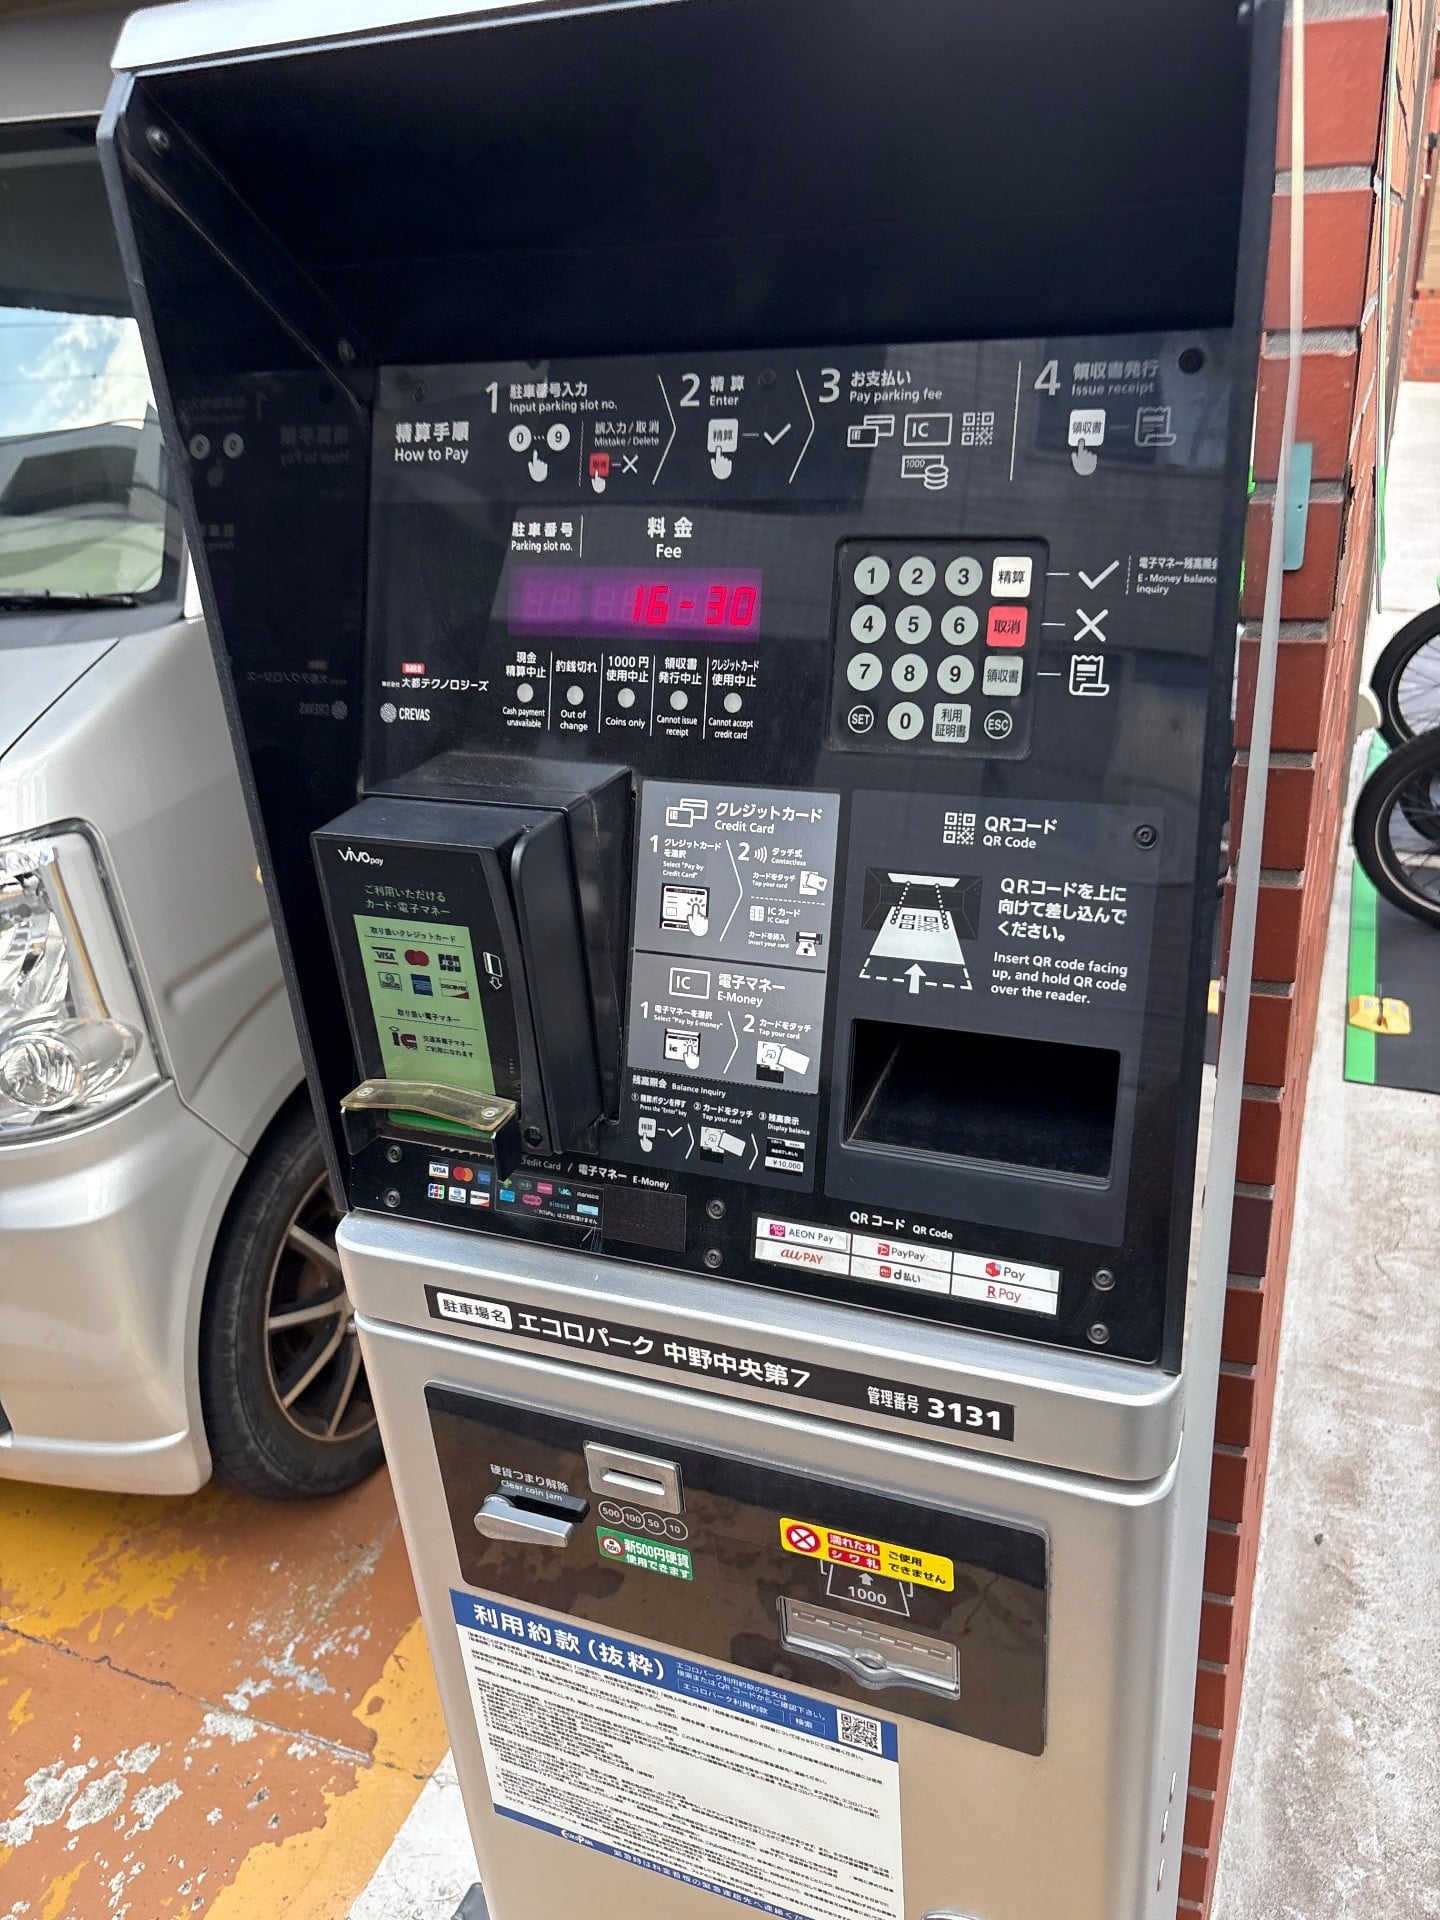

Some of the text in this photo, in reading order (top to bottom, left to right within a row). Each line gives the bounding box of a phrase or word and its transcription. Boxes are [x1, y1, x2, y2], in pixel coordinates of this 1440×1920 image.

[818, 368, 841, 403] 3
[850, 370, 912, 388] お支払い
[1034, 360, 1061, 396] 4
[509, 382, 588, 399] 駐車番号入力
[679, 373, 700, 407] 2
[849, 388, 943, 405] Pay parking fee
[1071, 381, 1155, 397] Issue receipt
[485, 382, 499, 414] 1
[510, 401, 536, 413] Input
[538, 400, 578, 413] parking
[580, 399, 599, 411] slot
[709, 395, 739, 407] Enter
[395, 421, 470, 441] 精算手順
[911, 421, 929, 438] IC
[395, 447, 469, 463] How to Pay
[905, 458, 925, 468] 1000
[512, 522, 574, 538] 駐車番号
[647, 516, 693, 539] 料金
[511, 540, 573, 554] Parking slot no.
[655, 543, 682, 558] Fee
[867, 568, 876, 584] 1
[911, 568, 923, 584] 2
[957, 568, 970, 585] 3
[998, 569, 1025, 585] 精算
[862, 616, 874, 632] 4
[908, 616, 919, 633] 5
[953, 617, 965, 634] 6
[993, 619, 1021, 634] 取消
[516, 651, 537, 663] 現金
[664, 657, 697, 670] 領収書
[505, 665, 547, 679] 精算中止
[555, 659, 598, 674] 釣銭切れ
[711, 659, 759, 672] クレジットカード
[860, 663, 872, 680] 7
[903, 664, 915, 681] 8
[606, 669, 649, 683] 使用中止
[658, 672, 702, 685] 発行中止
[711, 673, 757, 688] 使用中止
[949, 666, 961, 683] 9
[987, 668, 1020, 684] 領収書
[401, 678, 489, 691] 大都テクノロジーズ
[399, 707, 431, 721] CREVAS
[502, 707, 545, 718] Cash payment
[560, 710, 587, 719] Out of
[656, 715, 698, 726] Cannot issue
[851, 712, 871, 725] SET
[941, 708, 962, 722] 利用
[506, 718, 542, 729] unavailable
[560, 721, 588, 731] change
[605, 717, 646, 729] Coins only
[708, 718, 754, 730] Cannot accept
[899, 713, 911, 730] 0
[987, 718, 1009, 731] ESC
[665, 727, 689, 738] receipt
[714, 729, 748, 739] credit card
[935, 723, 967, 738] 証明書
[716, 802, 823, 823] クレジットカード
[714, 820, 775, 834] Credit Card
[984, 816, 1058, 834] QRコード
[650, 835, 659, 853] 1
[664, 838, 722, 851] クレジットカード
[983, 835, 1037, 849] QR Code
[738, 842, 750, 861] 2
[771, 847, 803, 858] タッチ式
[752, 871, 796, 882] カードをタッチ
[1000, 877, 1127, 902] QRコードを上に
[998, 900, 1127, 925] 向けて差し込んで
[997, 923, 1066, 942] ください。
[993, 951, 1128, 977] Insert QR code facing
[676, 975, 691, 990] IC
[718, 973, 786, 993] 電子マネー
[992, 968, 1127, 991] up, and hold QR code
[717, 991, 763, 1008] E-Money
[990, 983, 1091, 1004] over the reader.
[640, 1001, 649, 1019] 1
[743, 1014, 755, 1033] 2
[759, 1018, 812, 1033] カードをタッチ
[758, 1028, 800, 1040] Tap your card
[578, 1163, 627, 1181] 電子マネー
[632, 1175, 669, 1190] E-Money
[789, 1228, 815, 1240] AEON
[818, 1232, 834, 1244] Pay
[913, 1224, 927, 1236] QR
[929, 1225, 953, 1240] Code
[891, 1247, 926, 1262] PayPay
[893, 1269, 921, 1283] d払い
[1003, 1266, 1026, 1282] Pay
[443, 1298, 1002, 1432] 駐車場名 エコロパーク 中野中央第7 管理番号 3131
[489, 1463, 570, 1493] 硬貨つまり解除
[500, 1479, 563, 1502] Clear coin jam
[602, 1507, 681, 1534] 500 100 50 10
[829, 1533, 879, 1555] 濡れた札
[624, 1538, 690, 1568] 新500円硬貨
[830, 1549, 880, 1570] シワ札
[888, 1550, 923, 1567] ご使用
[626, 1554, 690, 1579] 使用できます
[887, 1562, 947, 1585] できません
[847, 1585, 887, 1605] 1000
[683, 1682, 768, 1715] エコロパーク利用約款
